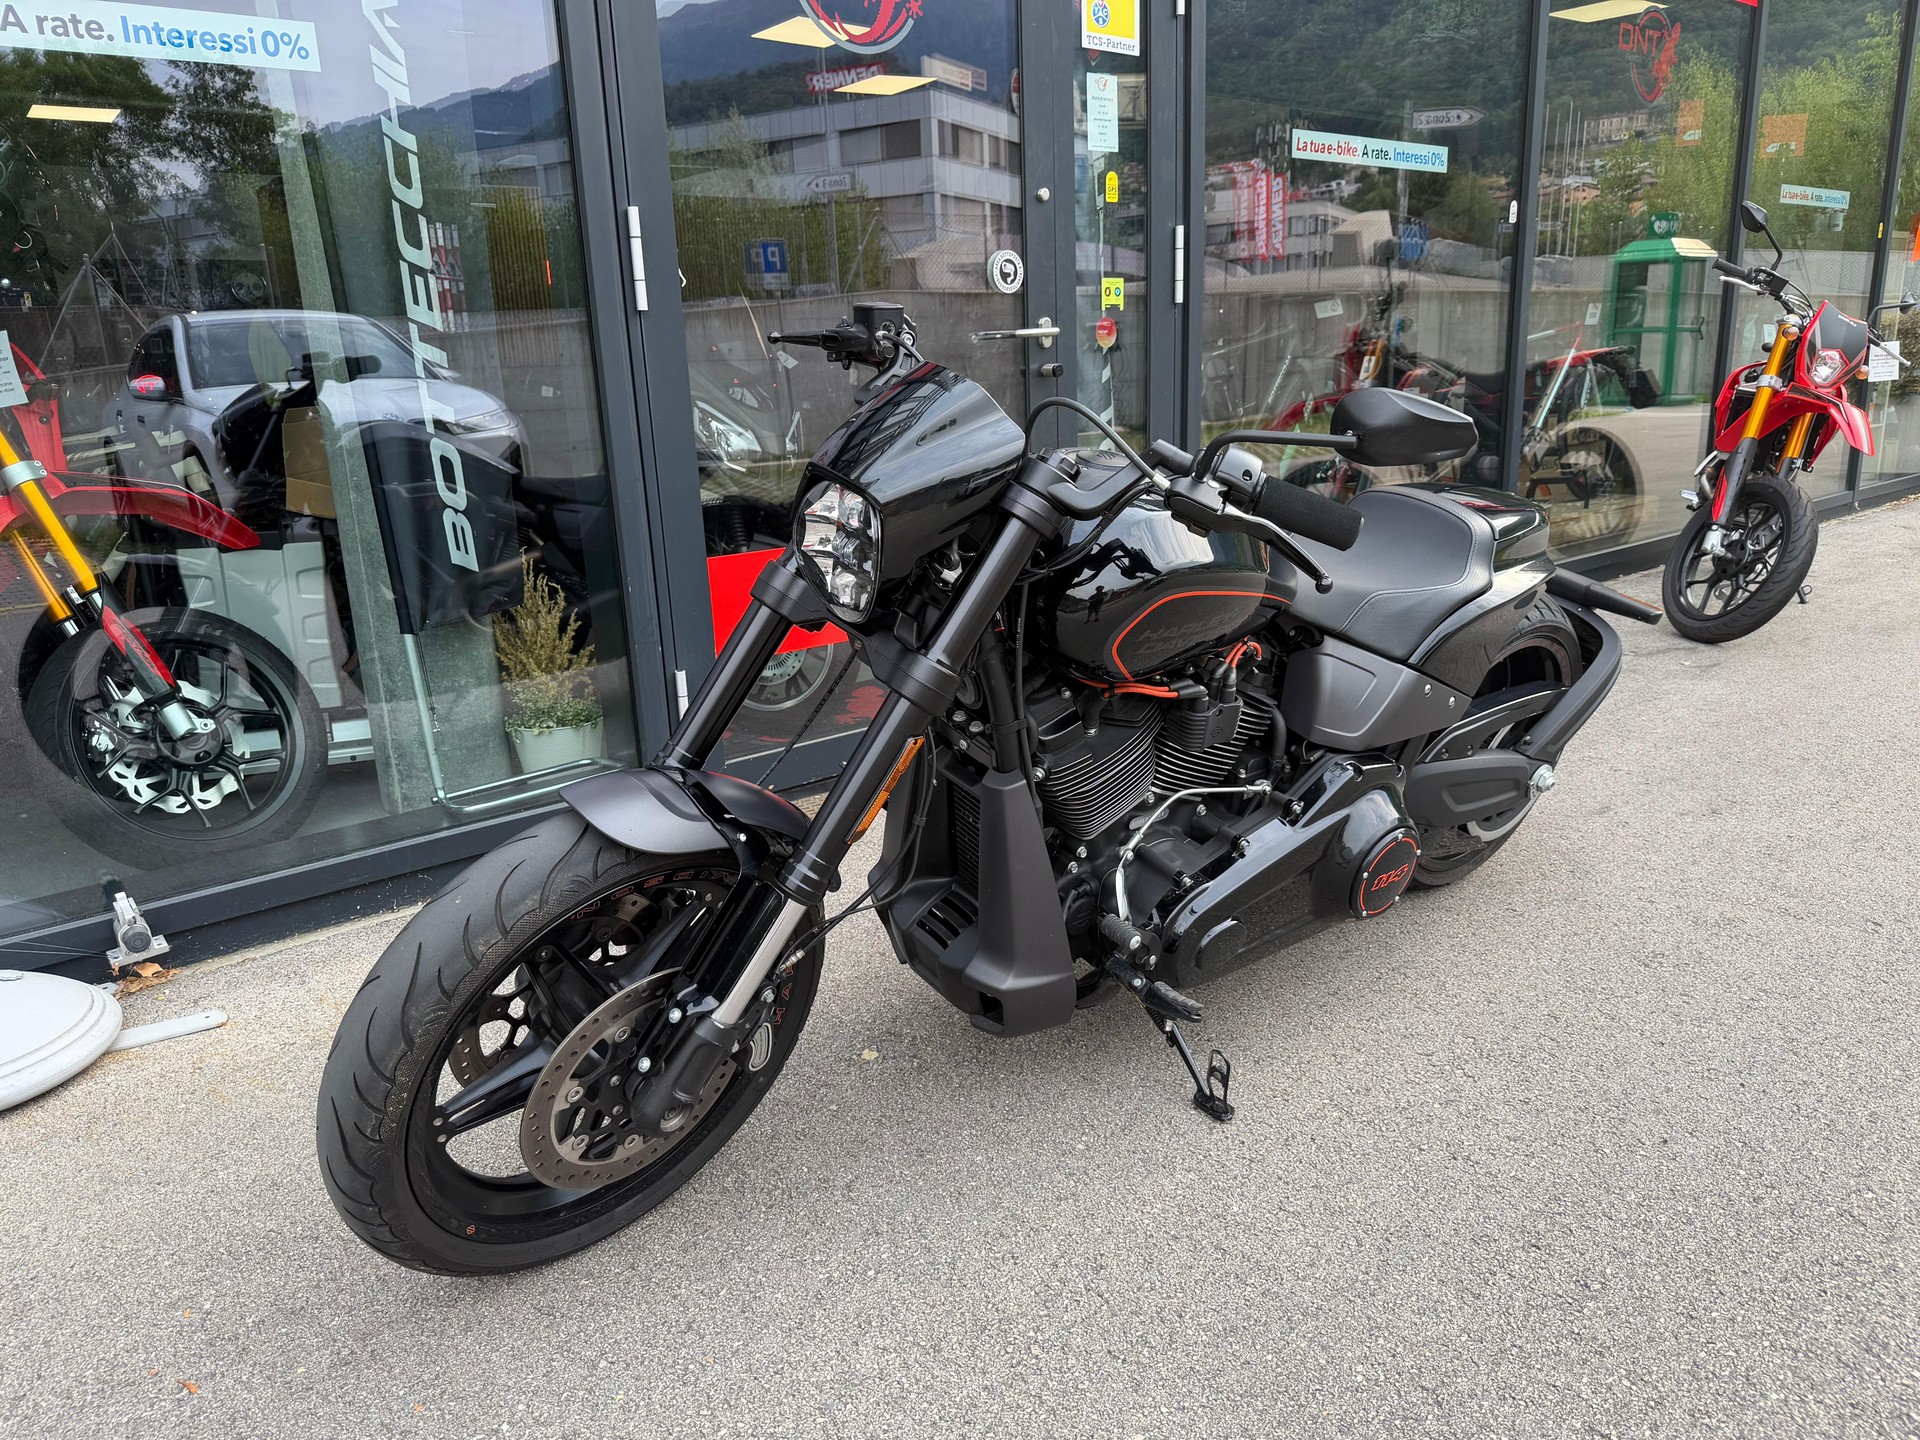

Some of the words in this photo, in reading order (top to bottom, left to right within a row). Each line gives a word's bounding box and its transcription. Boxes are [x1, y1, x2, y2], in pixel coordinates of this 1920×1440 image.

[0, 4, 28, 34] A
[35, 13, 115, 42] rate.
[120, 15, 257, 55] Interessi
[261, 29, 310, 60] 0%
[1086, 34, 1136, 52] TCS-Partner
[1296, 137, 1308, 152] La
[1309, 140, 1326, 154] tua
[1326, 141, 1360, 158] e-bike.
[1362, 144, 1369, 159] A
[1371, 147, 1392, 161] rate.
[1393, 147, 1430, 166] Interessi
[1431, 153, 1445, 167] 0%
[1370, 863, 1409, 891] 114
